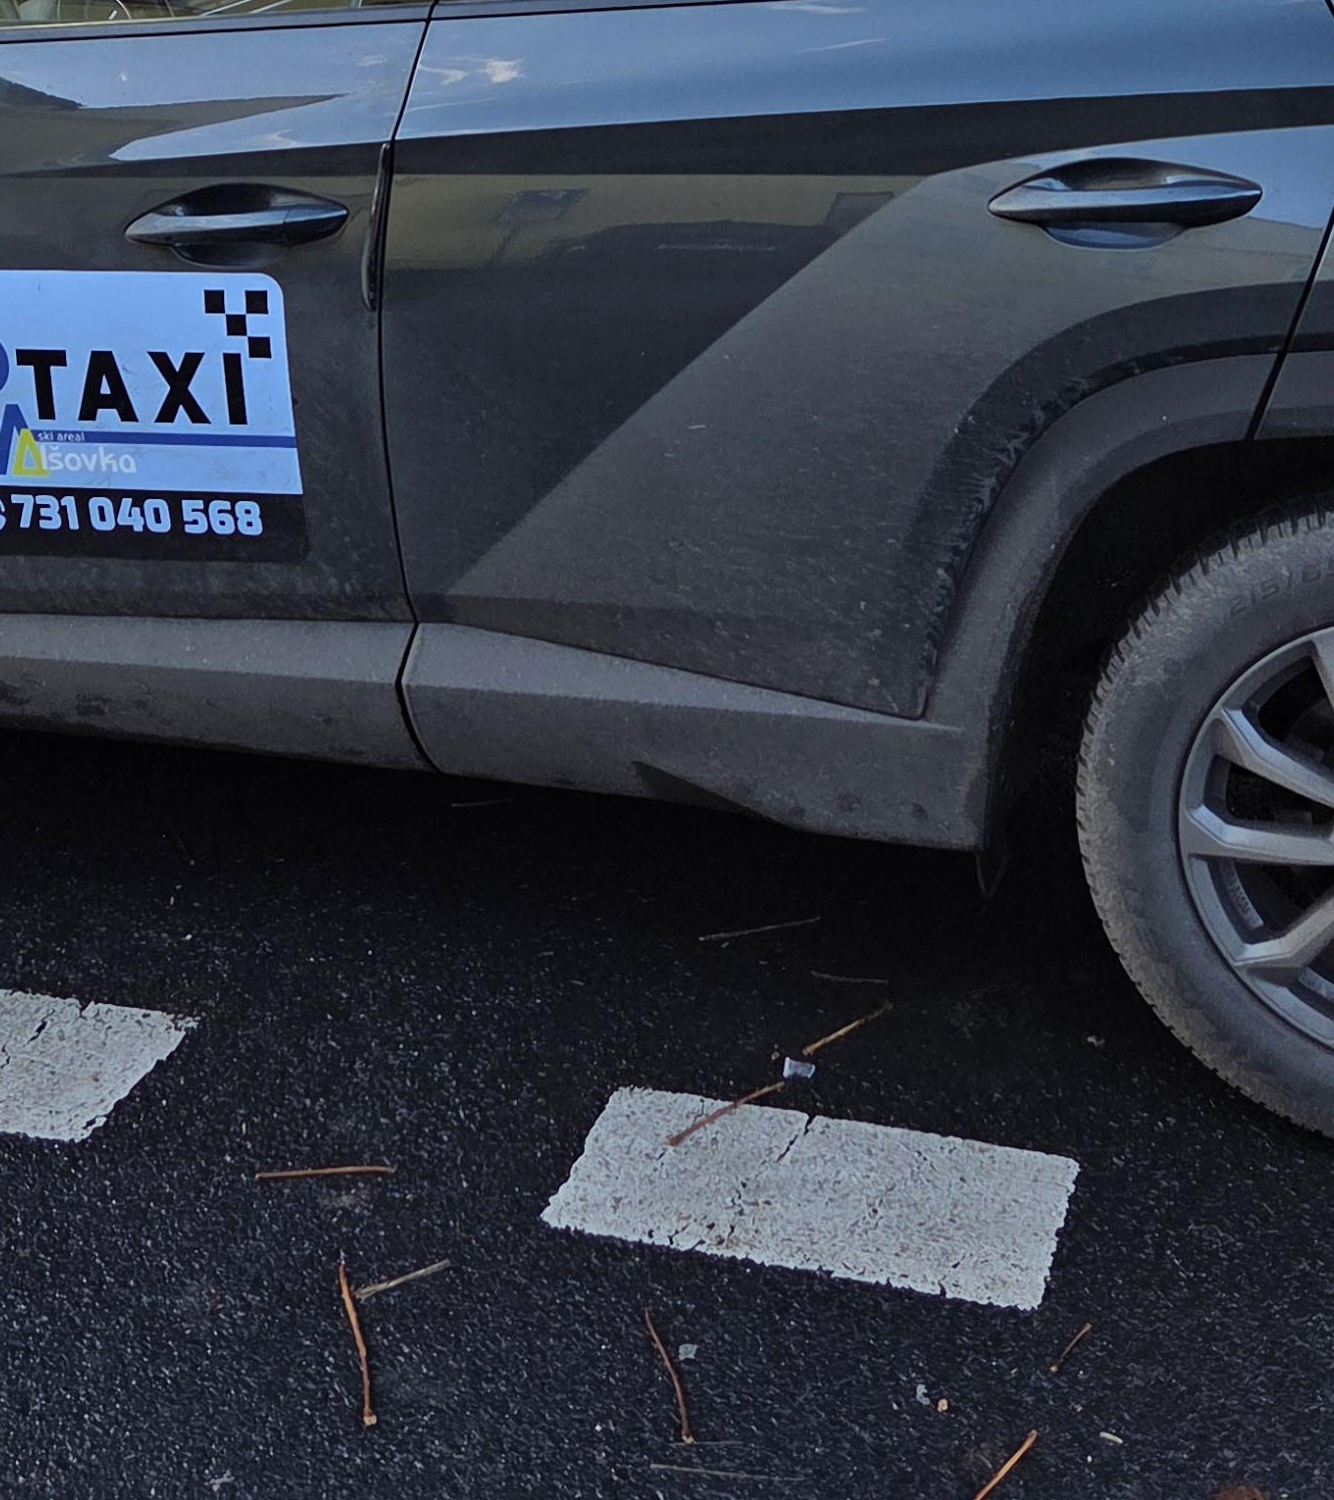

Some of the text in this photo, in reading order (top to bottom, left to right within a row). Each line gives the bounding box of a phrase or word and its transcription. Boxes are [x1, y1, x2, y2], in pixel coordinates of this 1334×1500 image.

[15, 348, 248, 426] TAXI
[37, 431, 85, 442] ski areal
[10, 493, 264, 537] 731 040 568
